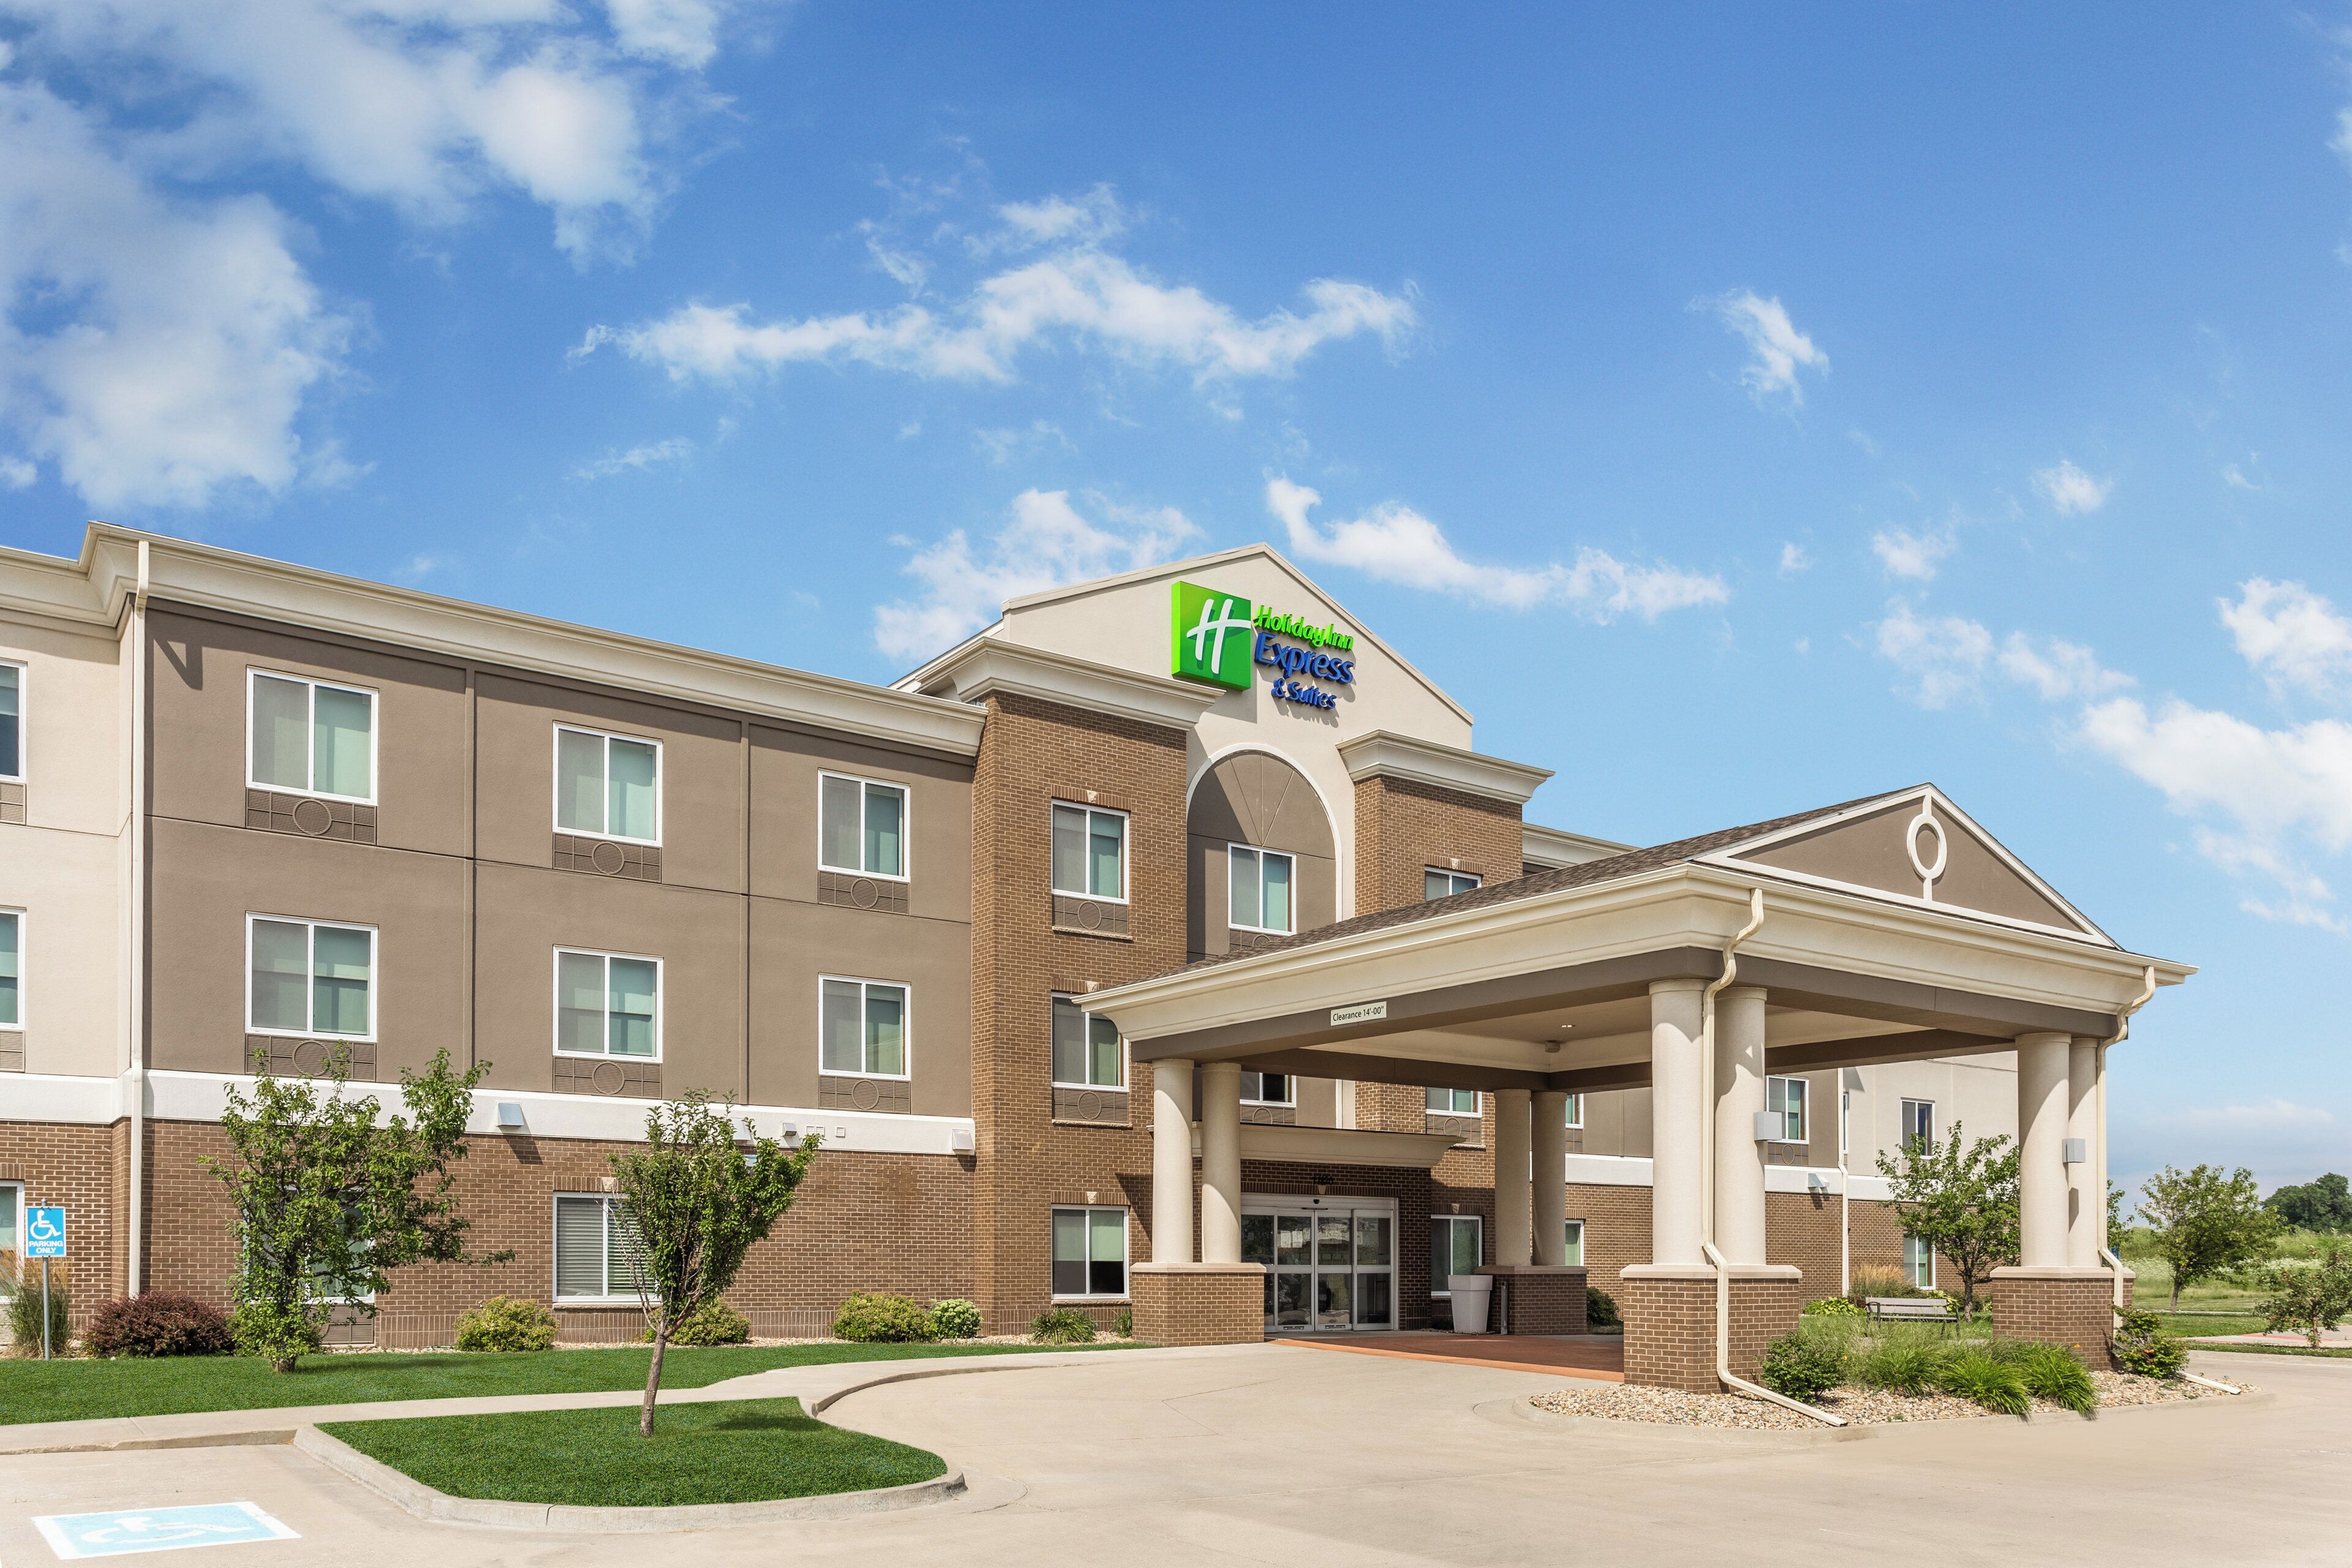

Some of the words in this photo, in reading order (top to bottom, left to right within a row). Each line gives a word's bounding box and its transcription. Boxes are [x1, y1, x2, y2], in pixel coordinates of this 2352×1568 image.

[1254, 605, 1325, 647] Holiday
[1325, 623, 1354, 650] Inn
[1254, 631, 1354, 685] Express
[1271, 678, 1286, 699] &
[1286, 681, 1338, 710] Suites
[1333, 1011, 1362, 1022] Clearance
